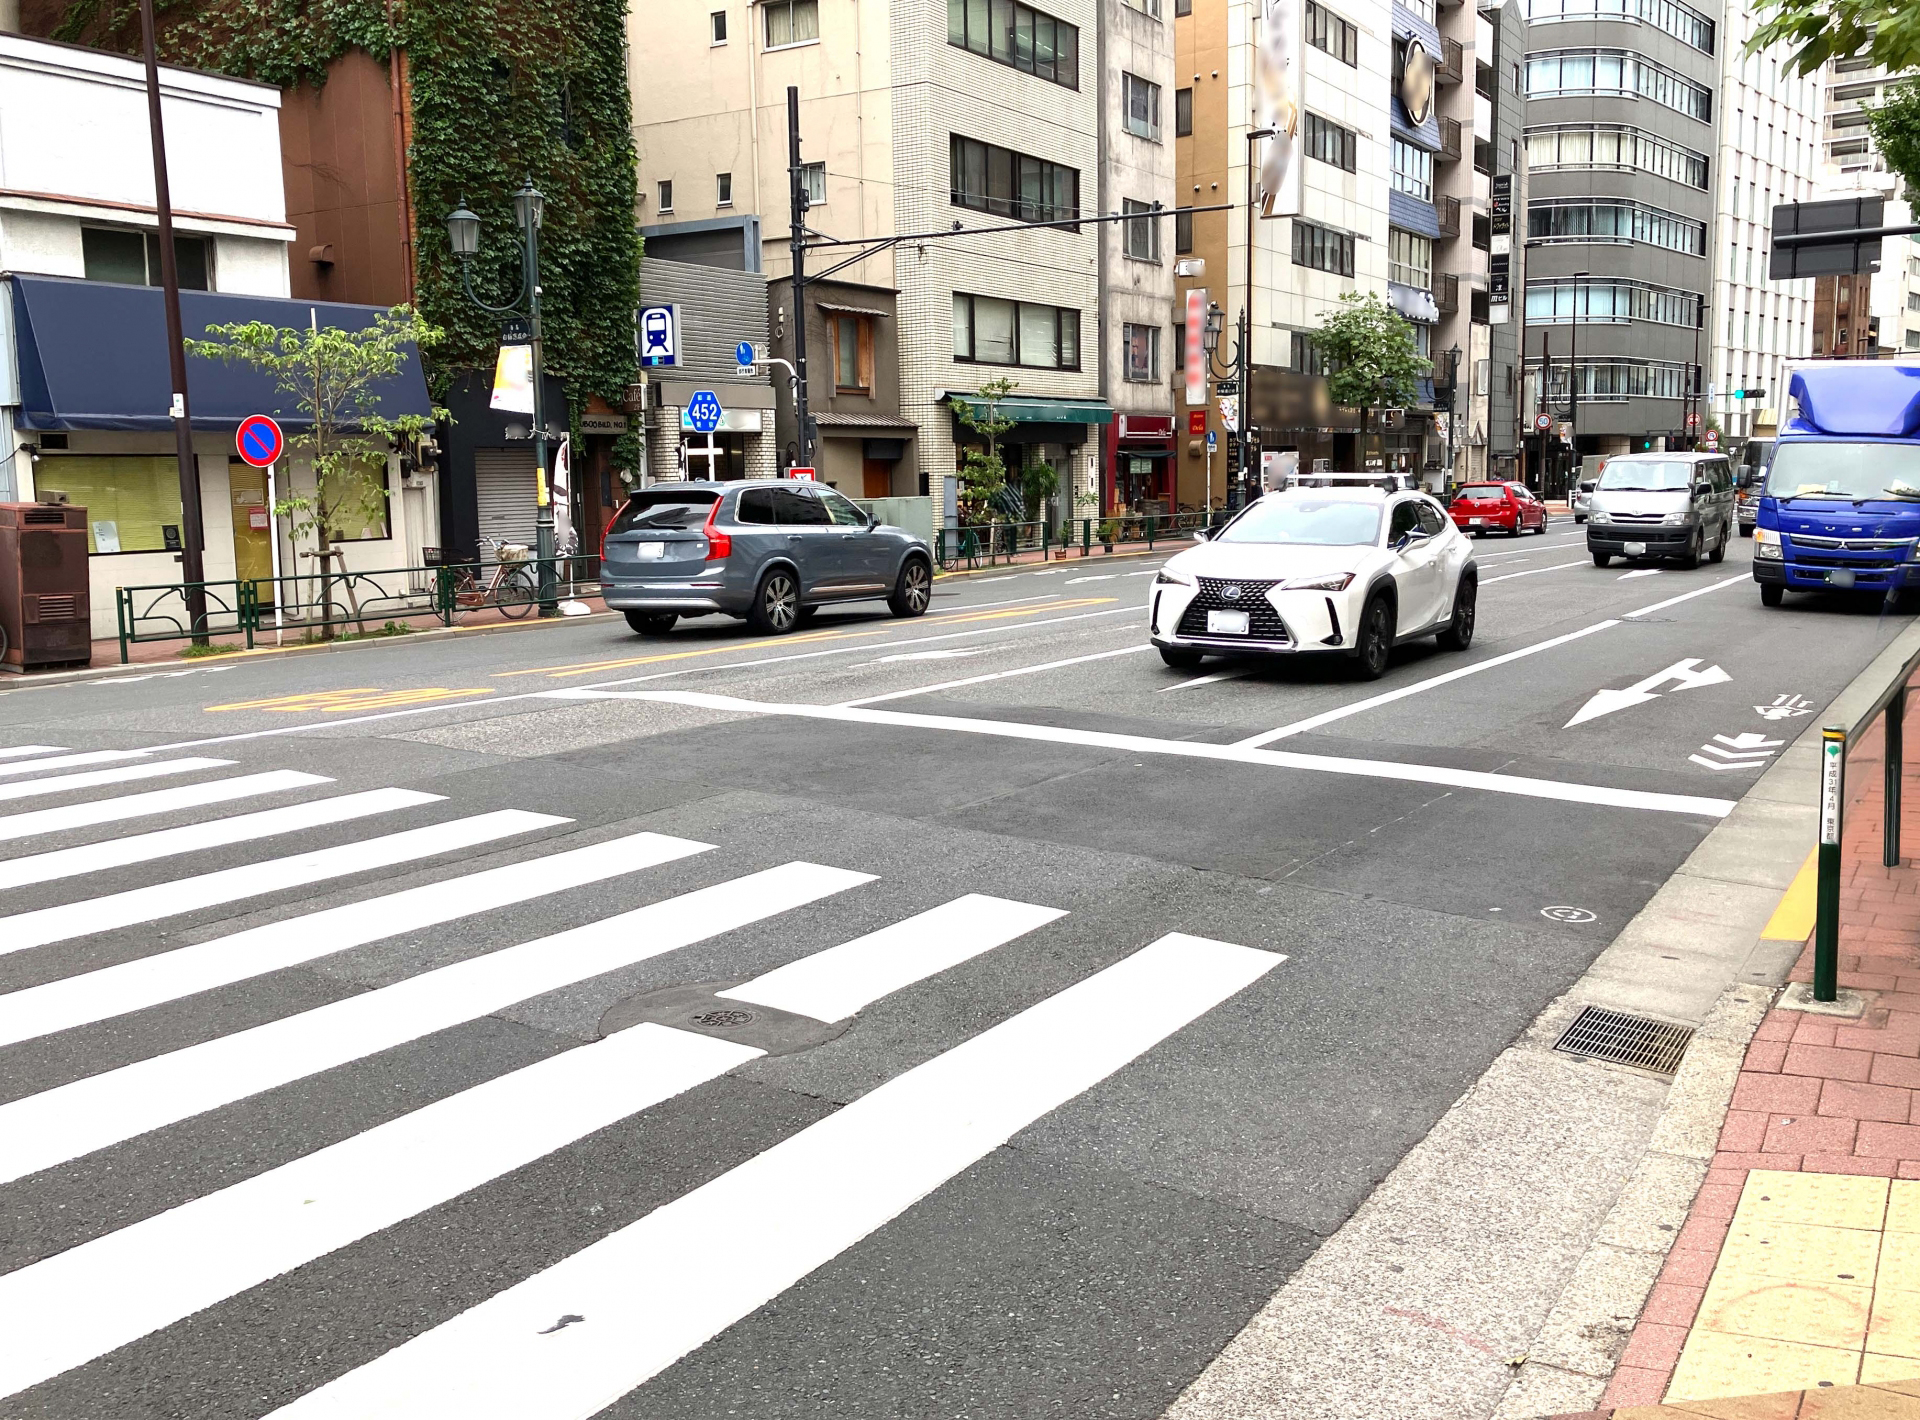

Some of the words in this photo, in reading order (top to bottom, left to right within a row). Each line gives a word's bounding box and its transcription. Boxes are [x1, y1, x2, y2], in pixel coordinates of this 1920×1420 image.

[622, 388, 641, 402] Café
[692, 403, 718, 420] 452
[1827, 761, 1837, 810] 平成31年4月
[1826, 817, 1835, 840] 東京都
